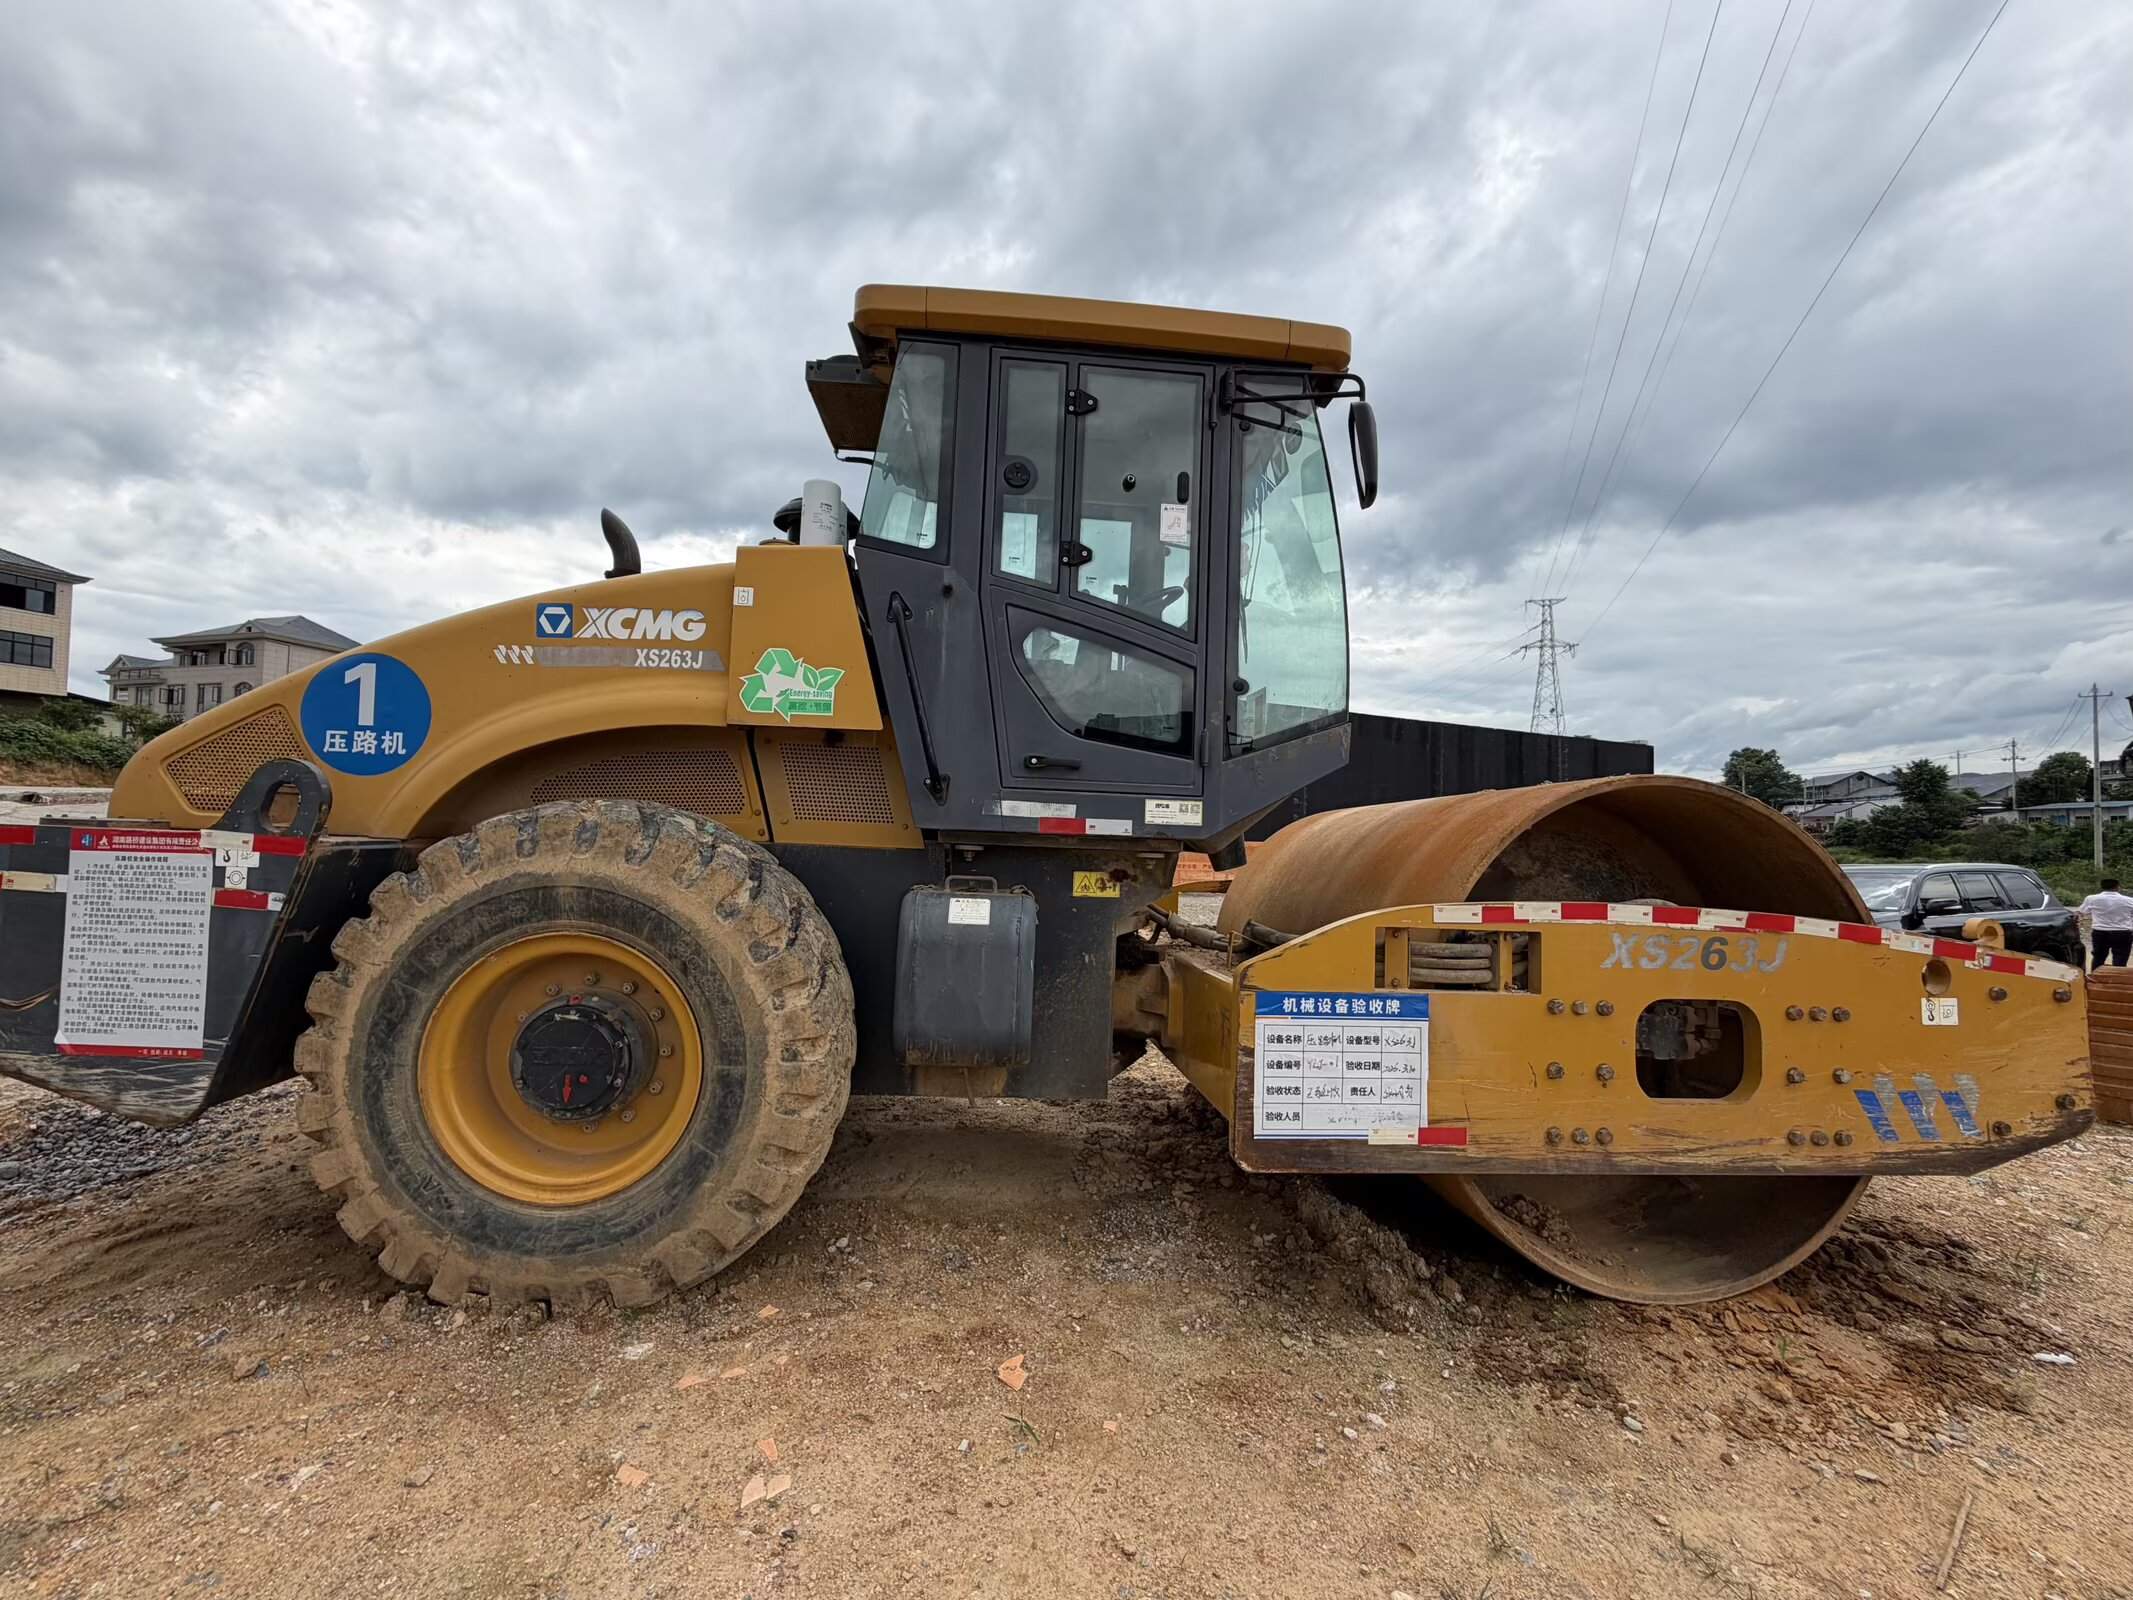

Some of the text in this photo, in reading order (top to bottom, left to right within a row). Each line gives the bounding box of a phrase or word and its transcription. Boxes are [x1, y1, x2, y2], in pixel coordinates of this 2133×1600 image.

[574, 607, 707, 641] XCMG
[635, 648, 703, 669] XS263J
[344, 661, 377, 726] 1
[323, 730, 407, 756] 压路机
[1600, 932, 1788, 972] XS263J
[1282, 997, 1401, 1015] 机械设备验收牌
[1266, 1034, 1302, 1045] 设备名称
[1346, 1035, 1380, 1045] 设备型号
[1266, 1060, 1301, 1071] 设备编号
[1345, 1061, 1380, 1071] 验收日期
[1266, 1086, 1301, 1096] 验收状态
[1350, 1086, 1376, 1097] 责任人
[1265, 1111, 1300, 1122] 验收人员
